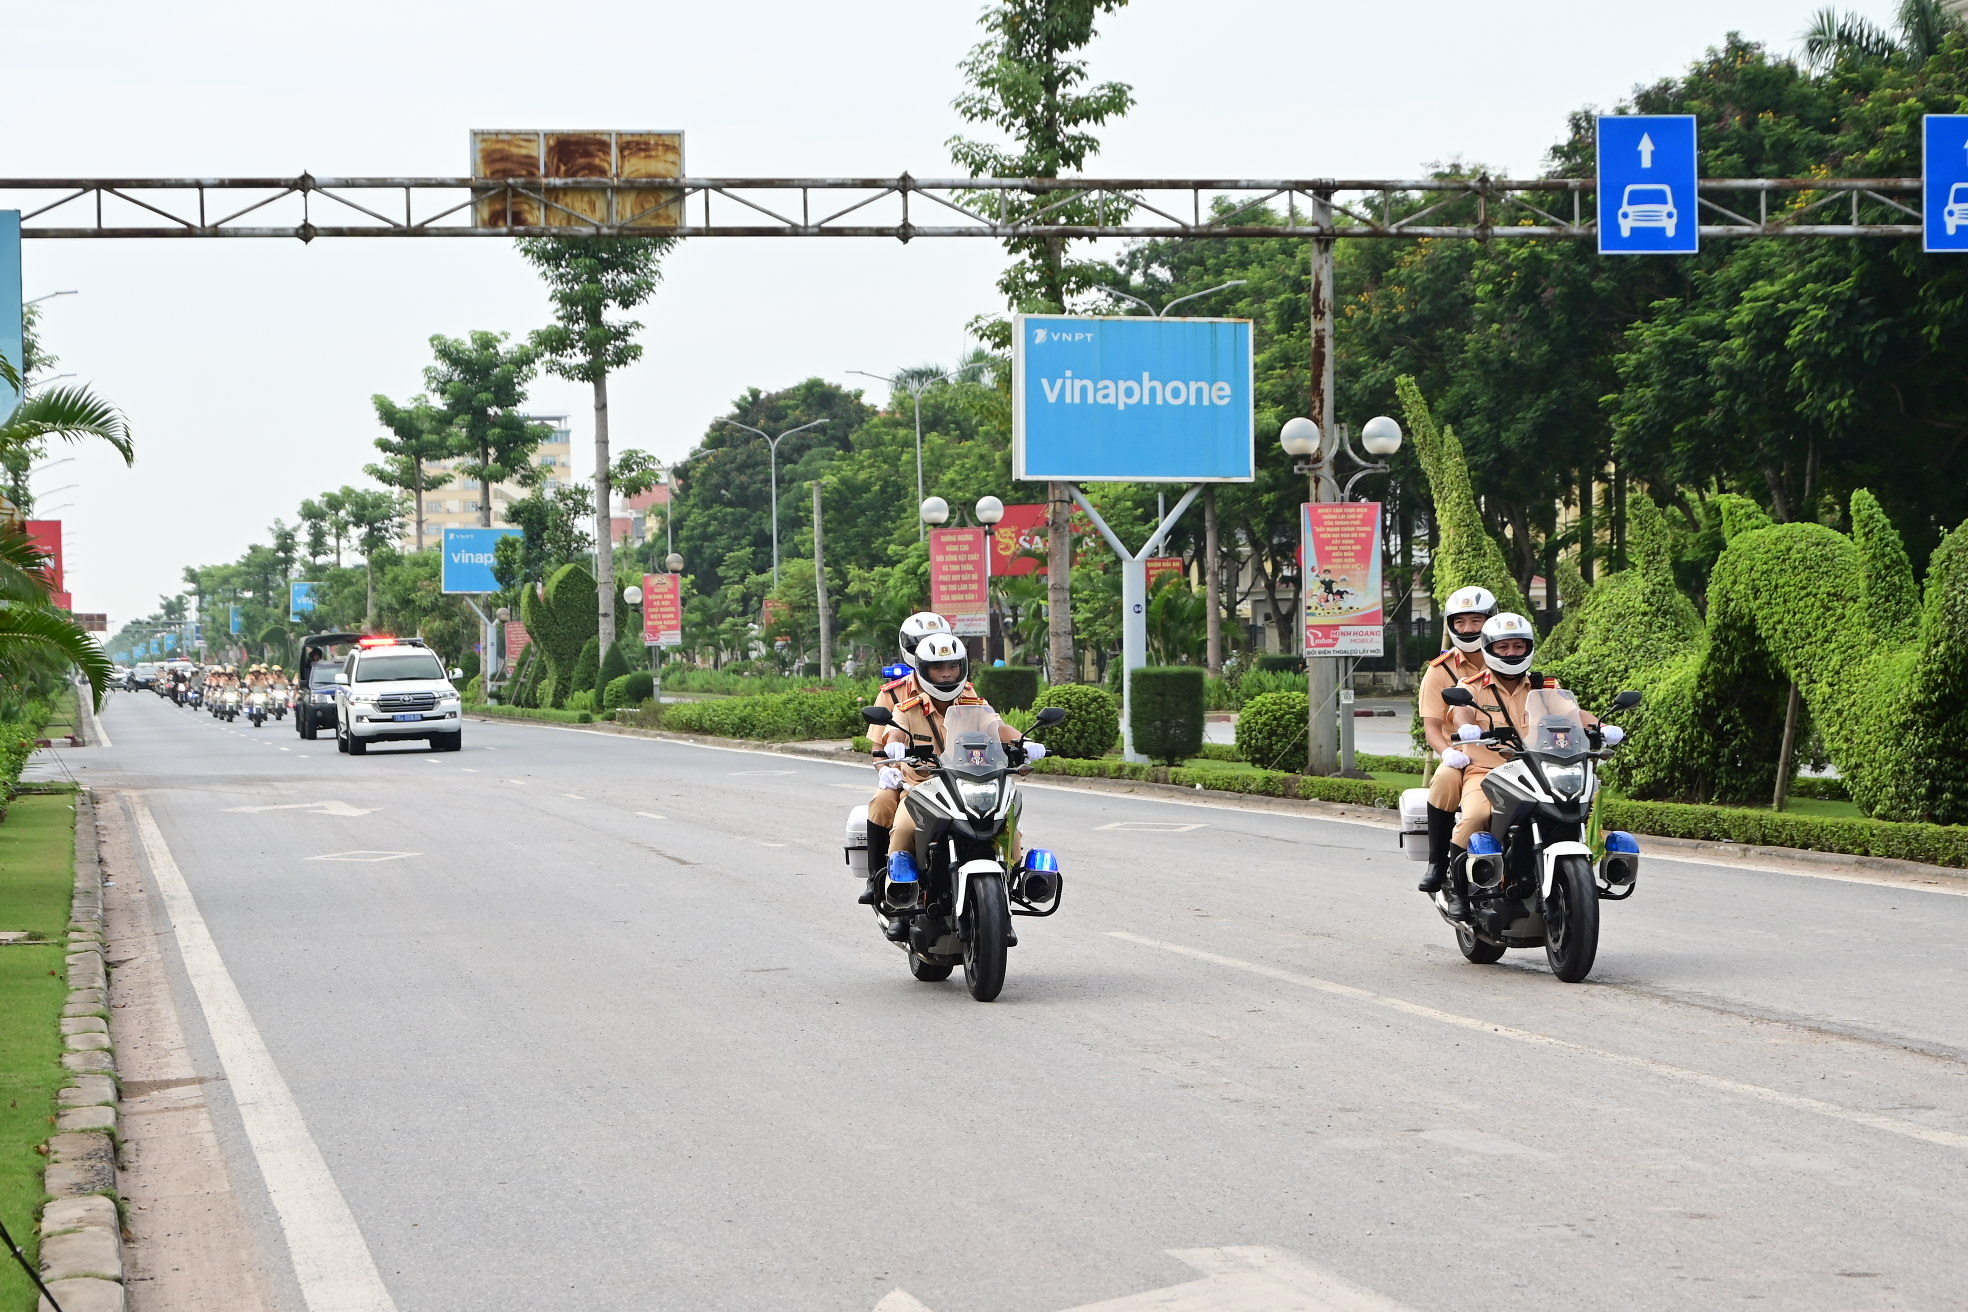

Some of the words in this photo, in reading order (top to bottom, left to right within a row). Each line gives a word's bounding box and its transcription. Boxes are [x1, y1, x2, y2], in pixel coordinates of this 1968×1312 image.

[1051, 332, 1094, 342] VNPT
[1041, 370, 1232, 410] vinaphone
[452, 549, 497, 566] vinap
